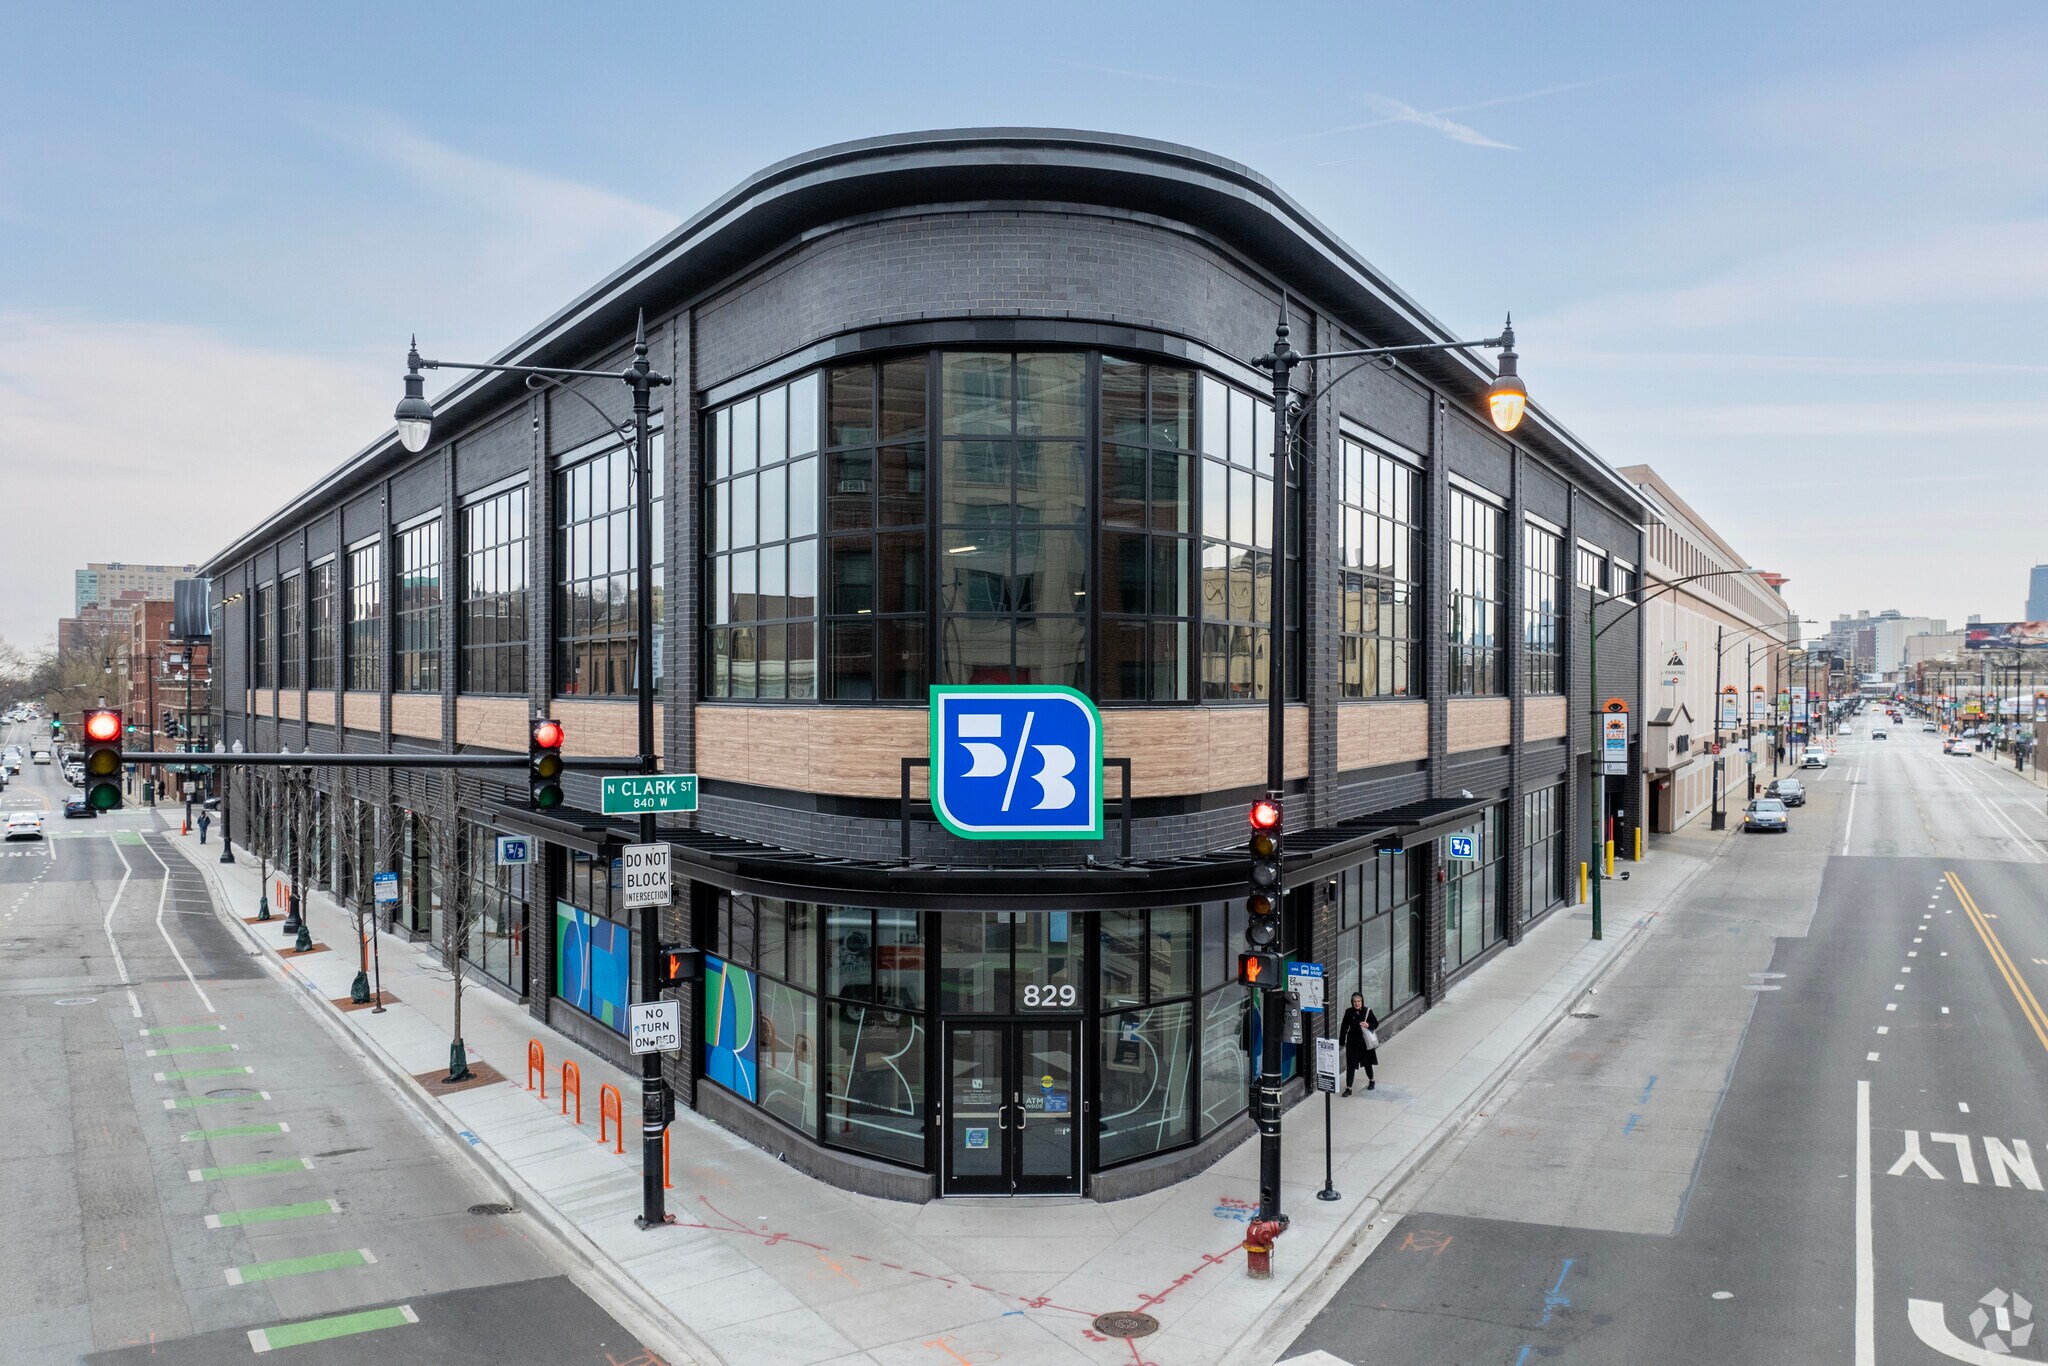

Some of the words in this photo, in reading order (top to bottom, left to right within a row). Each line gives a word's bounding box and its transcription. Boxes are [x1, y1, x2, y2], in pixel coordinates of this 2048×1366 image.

[607, 784, 615, 795] N
[621, 780, 676, 796] CLARK
[680, 781, 693, 792] ST
[633, 798, 655, 808] 840
[659, 797, 668, 807] W
[626, 854, 642, 868] DO
[645, 852, 667, 866] NOT
[627, 872, 667, 888] BLOCK
[627, 890, 668, 902] INTERSECTION
[1023, 984, 1076, 1007] 829
[645, 1008, 663, 1019] NO
[641, 1021, 669, 1033] TURN
[635, 1037, 649, 1047] ON
[1025, 1097, 1043, 1105] ATM
[1887, 1130, 2048, 1191] NLY
